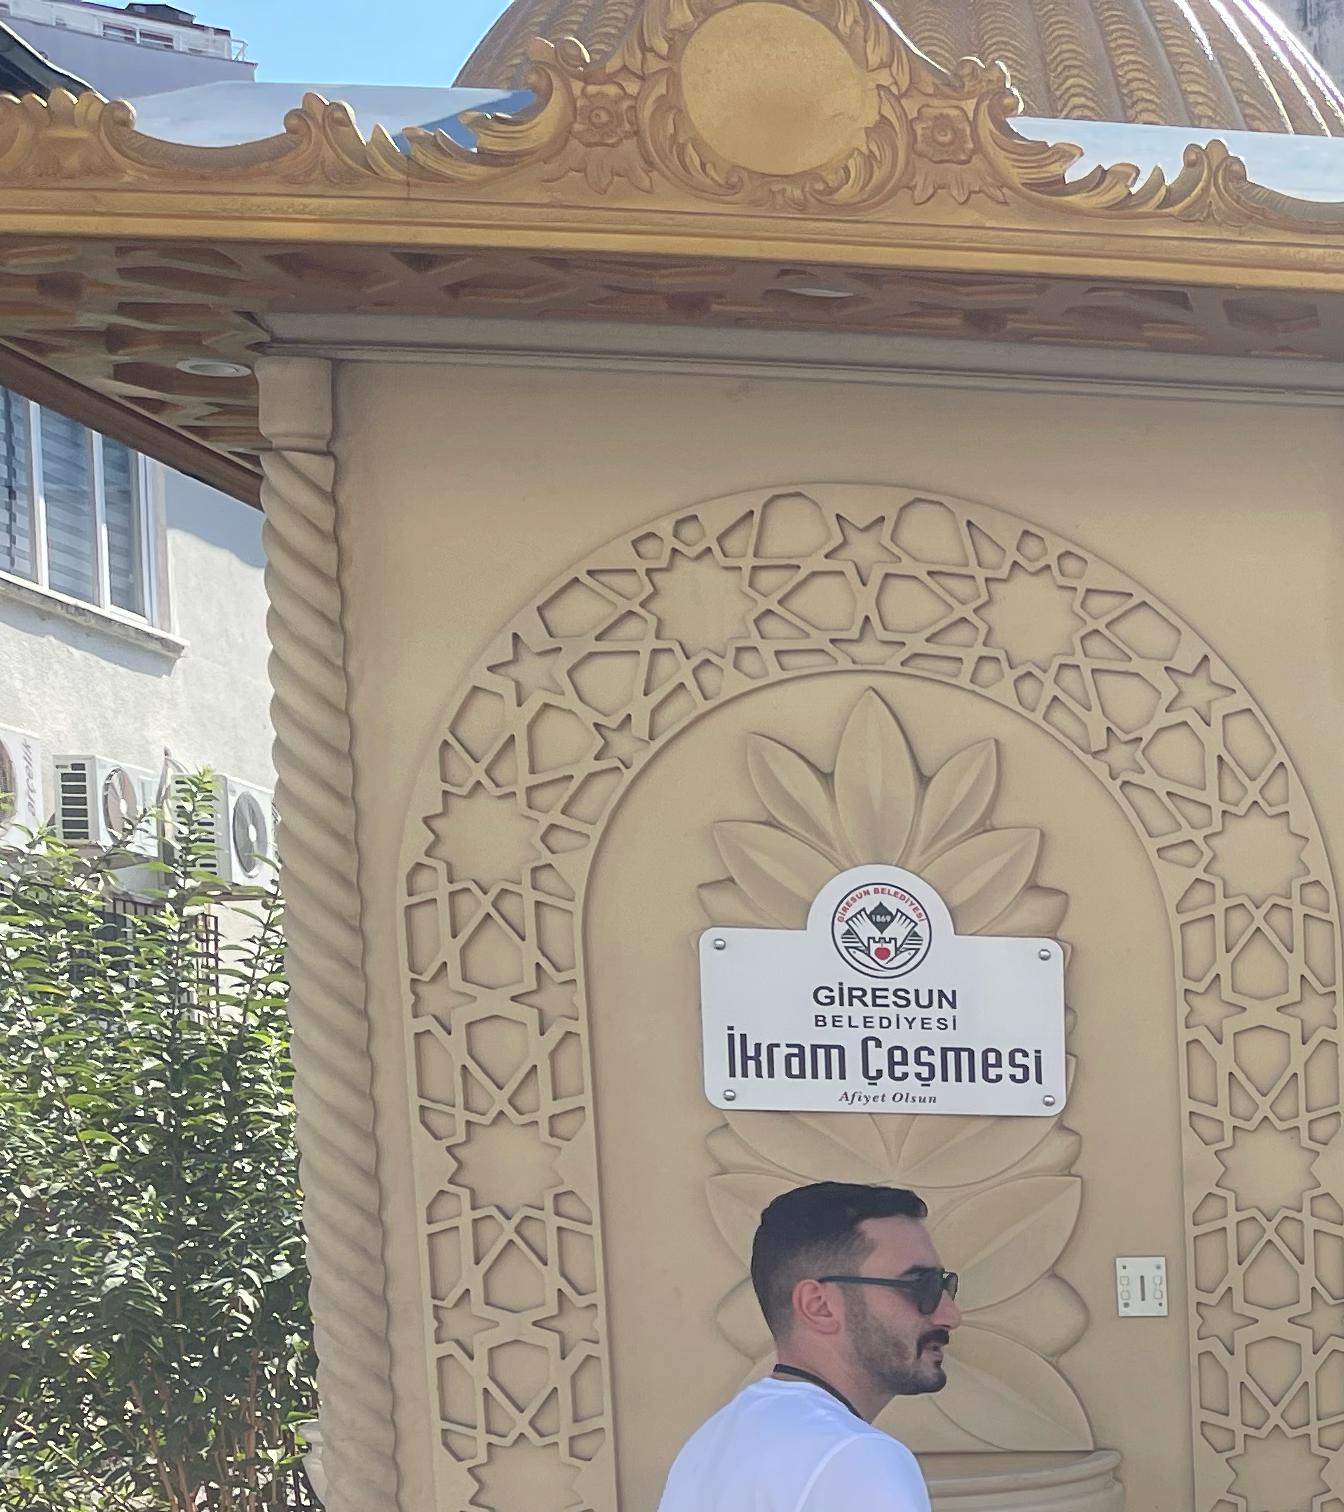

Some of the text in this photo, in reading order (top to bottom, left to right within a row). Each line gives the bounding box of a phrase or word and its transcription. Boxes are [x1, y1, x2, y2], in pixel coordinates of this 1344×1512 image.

[837, 888, 926, 922] GİRESUN BELEDİYESİ
[872, 914, 891, 923] 1869
[812, 982, 957, 1009] GİRESUN
[814, 1014, 957, 1030] BELEDİYESİ
[727, 1026, 1042, 1087] İkram Çeşmesi
[838, 1091, 937, 1106] Afiyet Olsun
